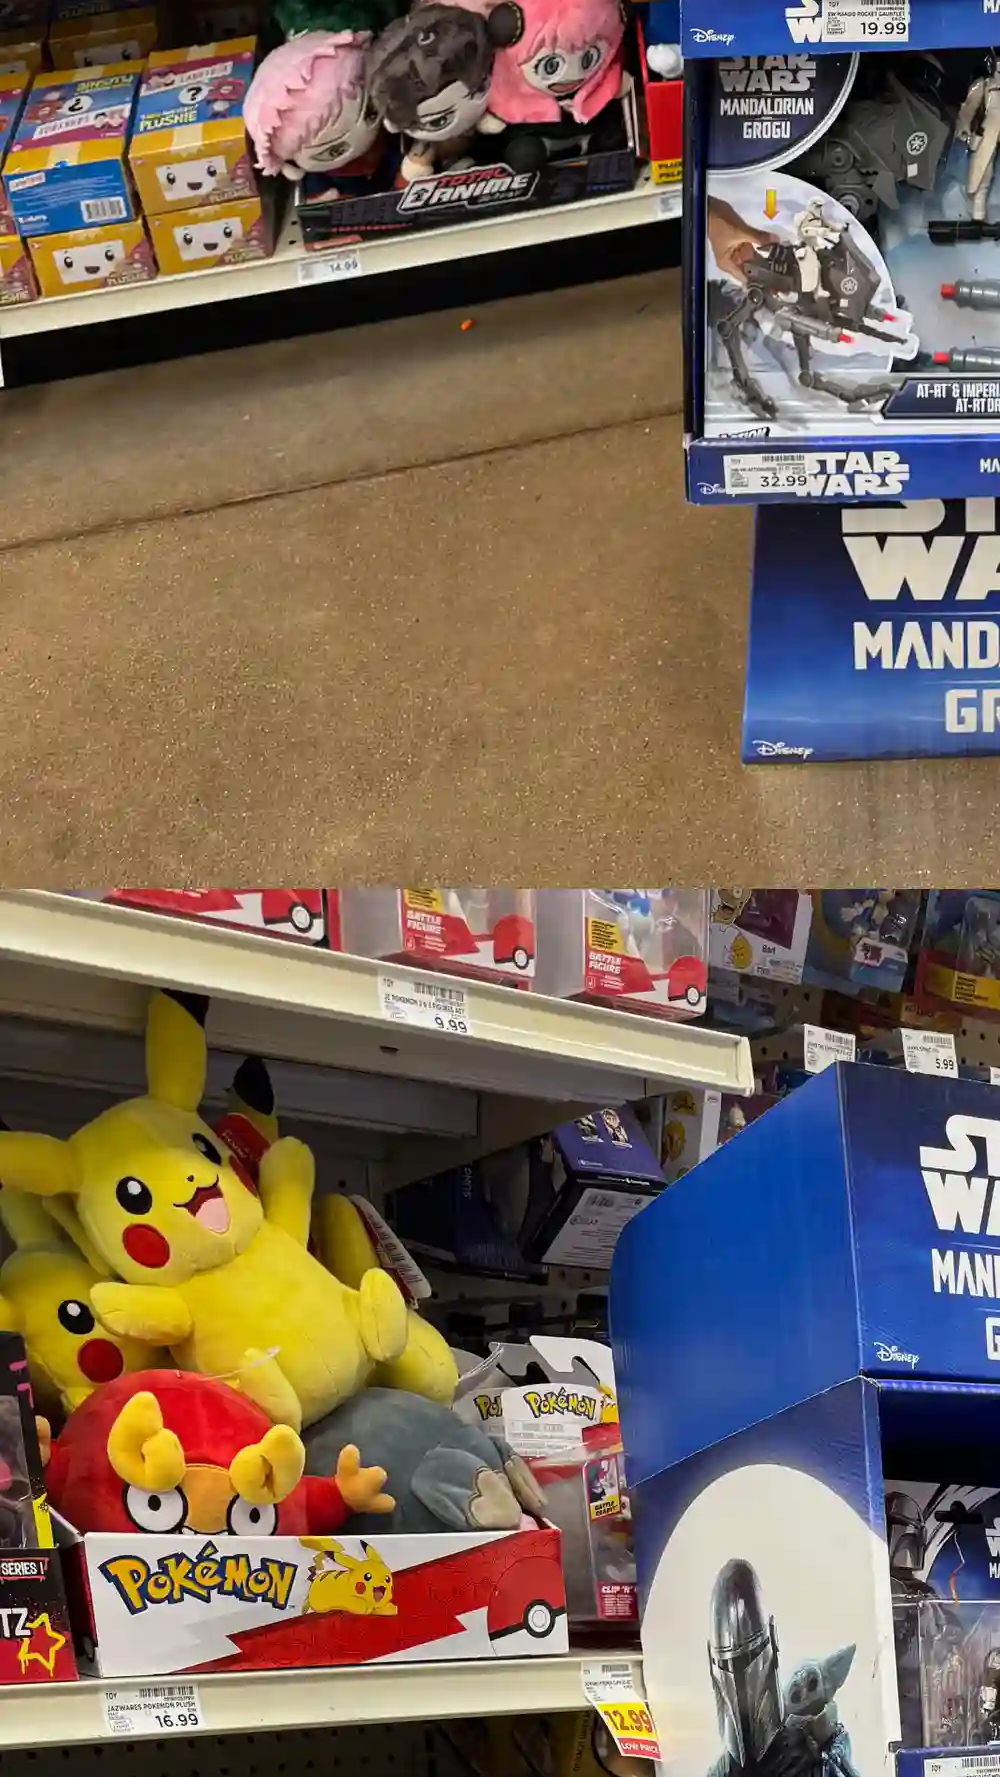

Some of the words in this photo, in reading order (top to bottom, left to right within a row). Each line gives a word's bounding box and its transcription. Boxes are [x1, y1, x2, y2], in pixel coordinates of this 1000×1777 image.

[859, 22, 908, 37] 19.99
[720, 68, 816, 93] WARS
[719, 96, 815, 117] MANDALORIAN
[139, 112, 198, 133] PLUSHIE
[742, 118, 791, 140] GROGU
[427, 175, 532, 205] ANIME
[759, 473, 808, 489] 32.99
[434, 1016, 468, 1034] 9.99
[106, 1702, 142, 1712] JAZWARES
[142, 1702, 171, 1711] POKEMON
[171, 1701, 197, 1711] PLUSH
[155, 1712, 199, 1730] 16.99
[603, 1709, 653, 1735] 12.99
